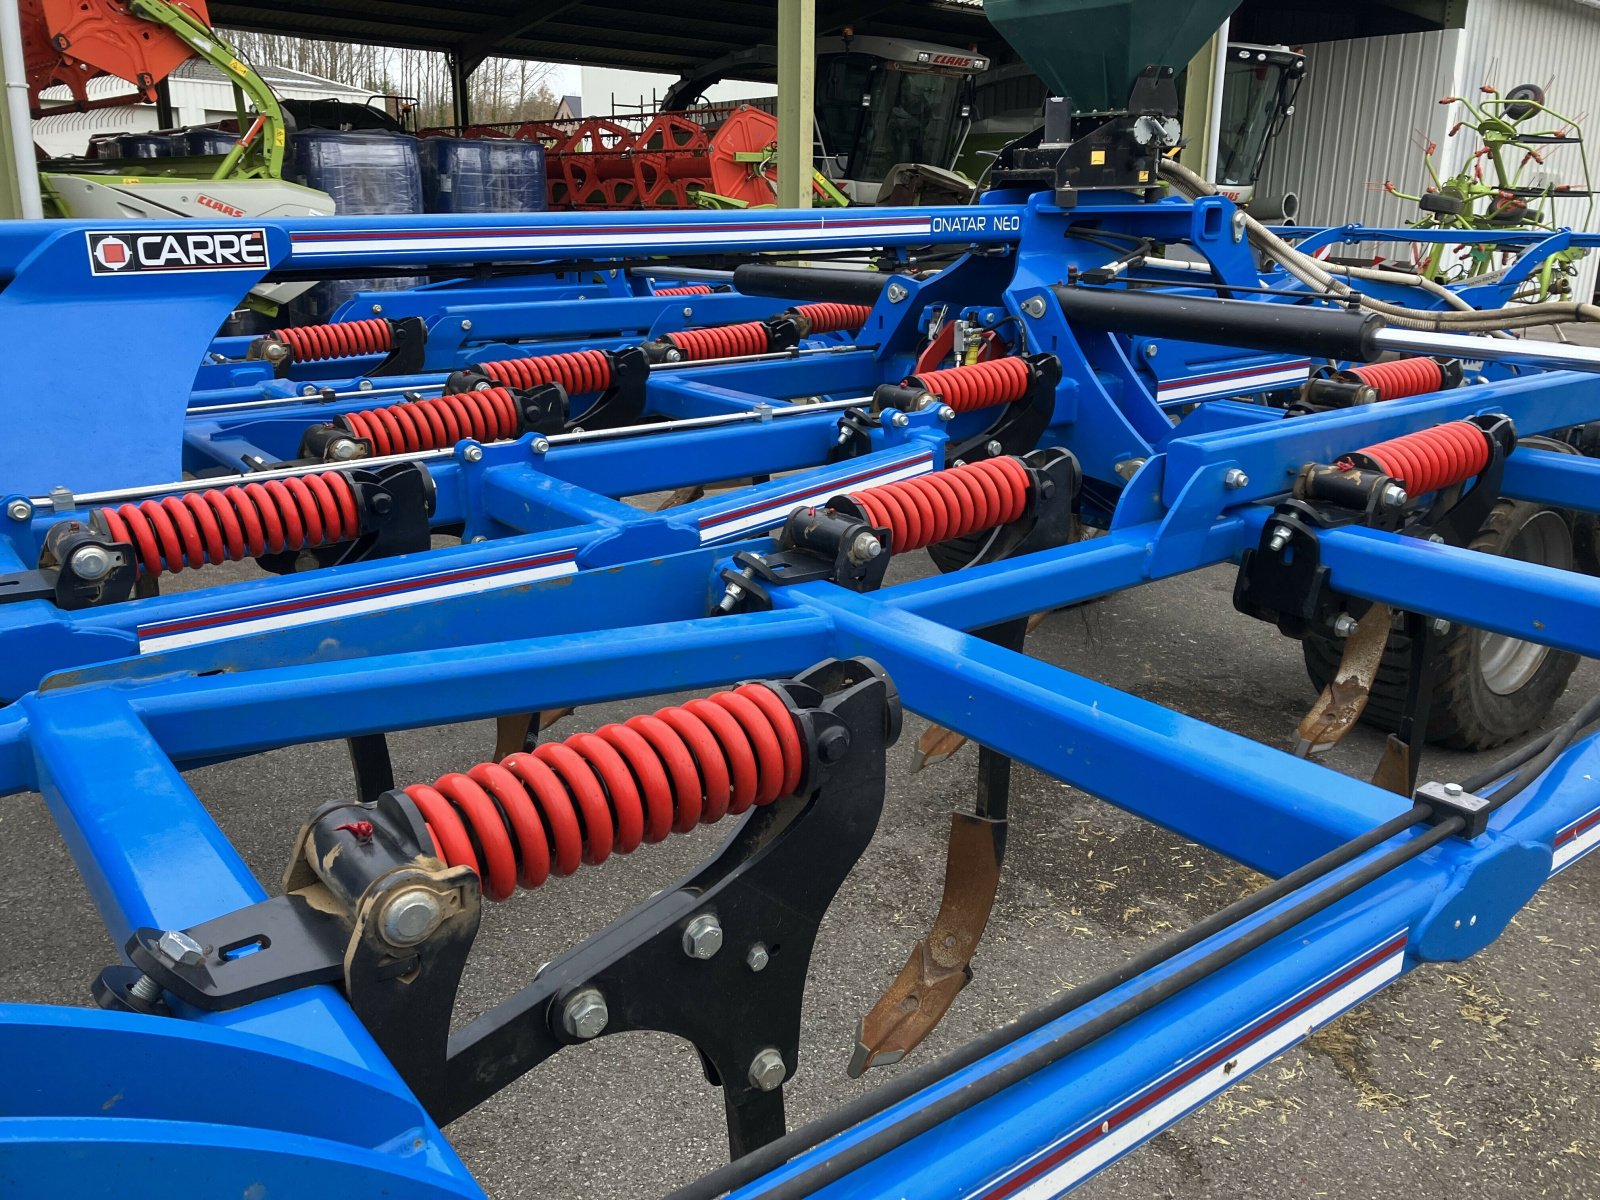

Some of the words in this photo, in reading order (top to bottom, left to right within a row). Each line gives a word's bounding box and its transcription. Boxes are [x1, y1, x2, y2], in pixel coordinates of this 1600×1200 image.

[932, 54, 971, 67] CLAAS
[197, 195, 243, 217] CLAAS
[933, 217, 986, 232] ONATAR
[993, 216, 1020, 231] NEO
